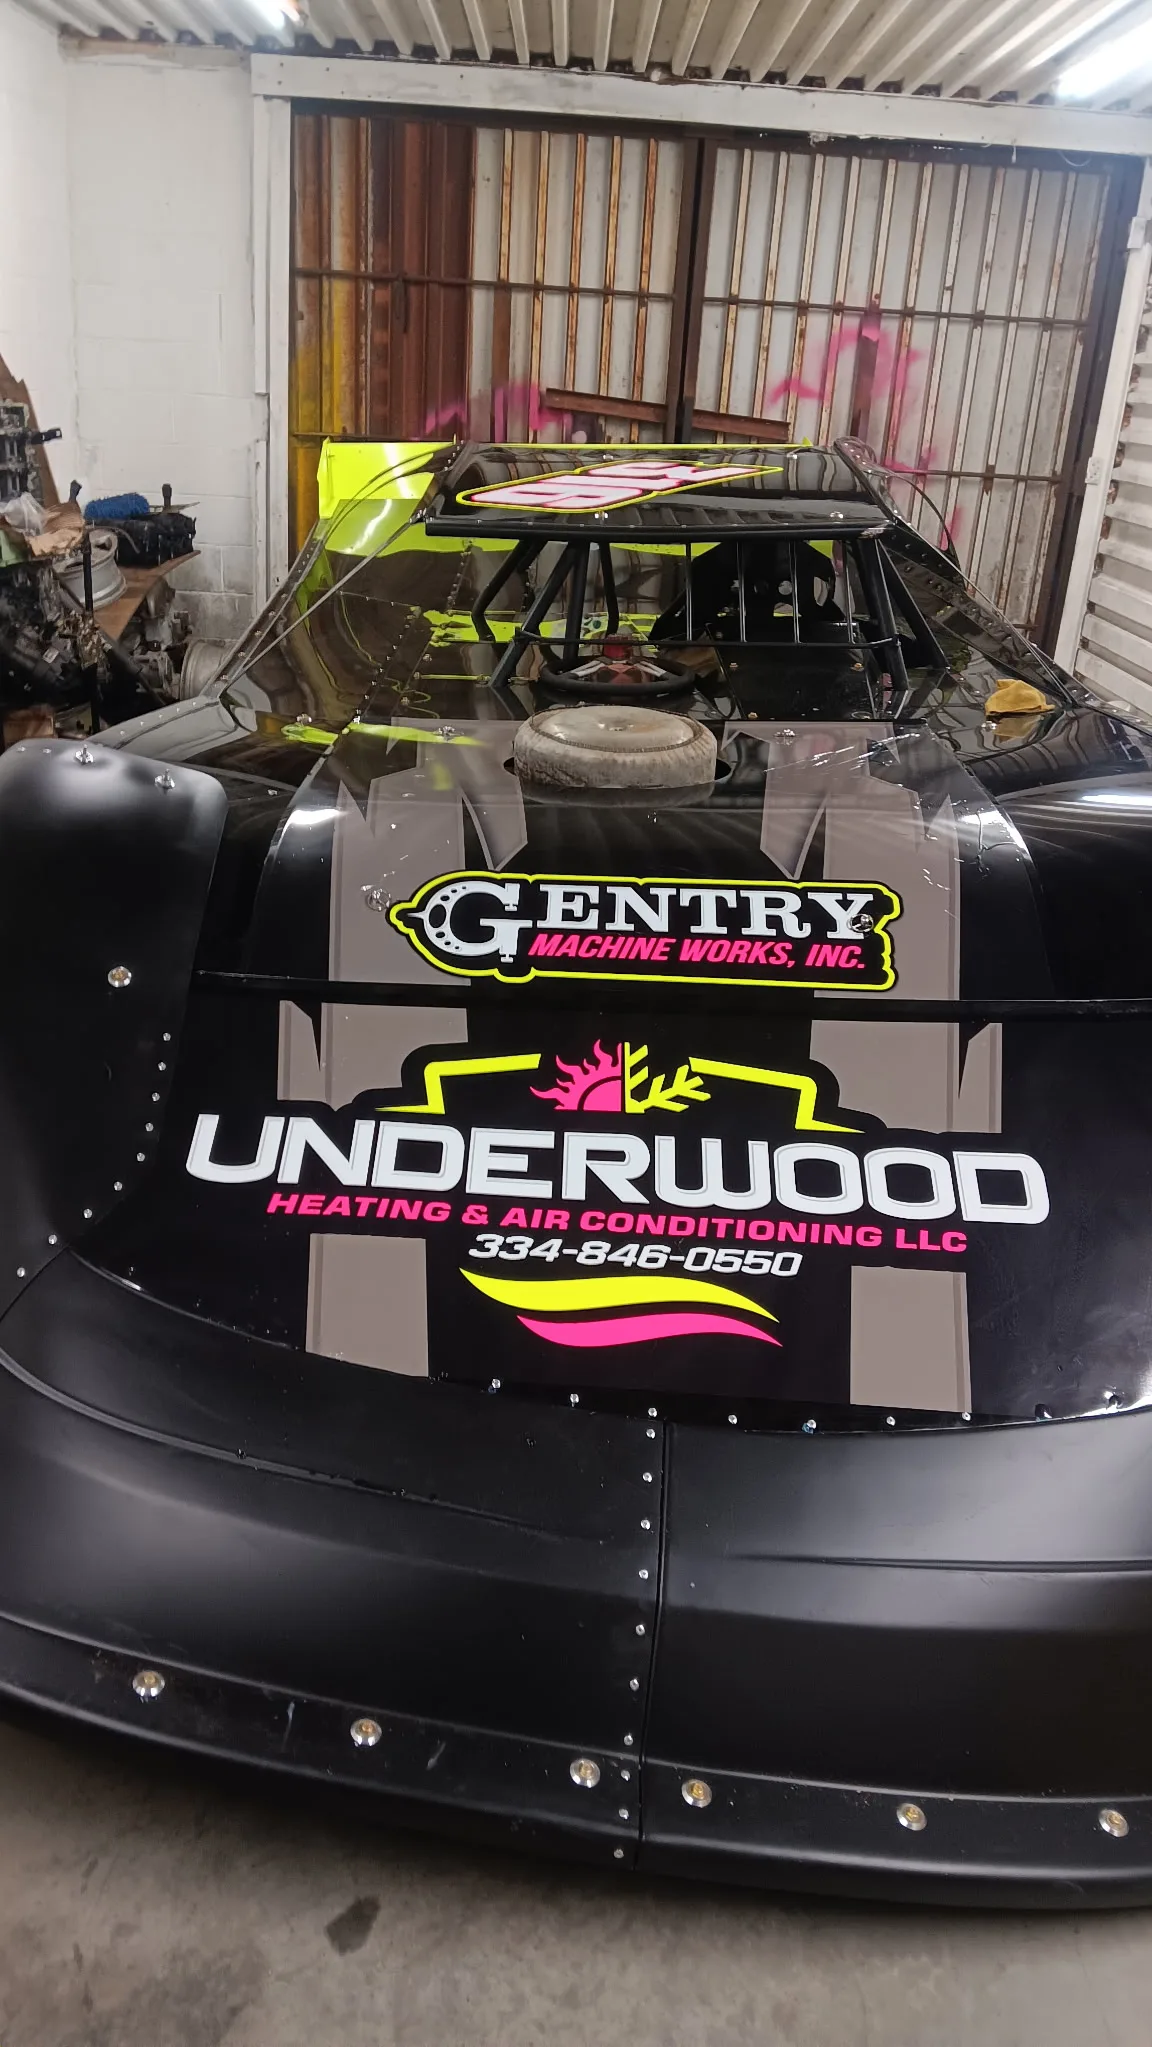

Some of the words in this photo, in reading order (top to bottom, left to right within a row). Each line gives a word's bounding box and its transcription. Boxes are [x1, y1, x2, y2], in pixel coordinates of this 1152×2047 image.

[406, 880, 876, 963] GENTRY
[527, 932, 678, 962] MACHINE
[679, 937, 797, 969] WORKS,
[804, 942, 866, 969] INC.
[184, 1112, 1051, 1225] UNDERWOOD
[265, 1191, 453, 1223] HEATING
[460, 1203, 490, 1226] &
[498, 1206, 571, 1231] AIR
[579, 1210, 884, 1248] CONDITIONING
[894, 1228, 968, 1253] LLC
[467, 1232, 804, 1278] 334-846-0550
